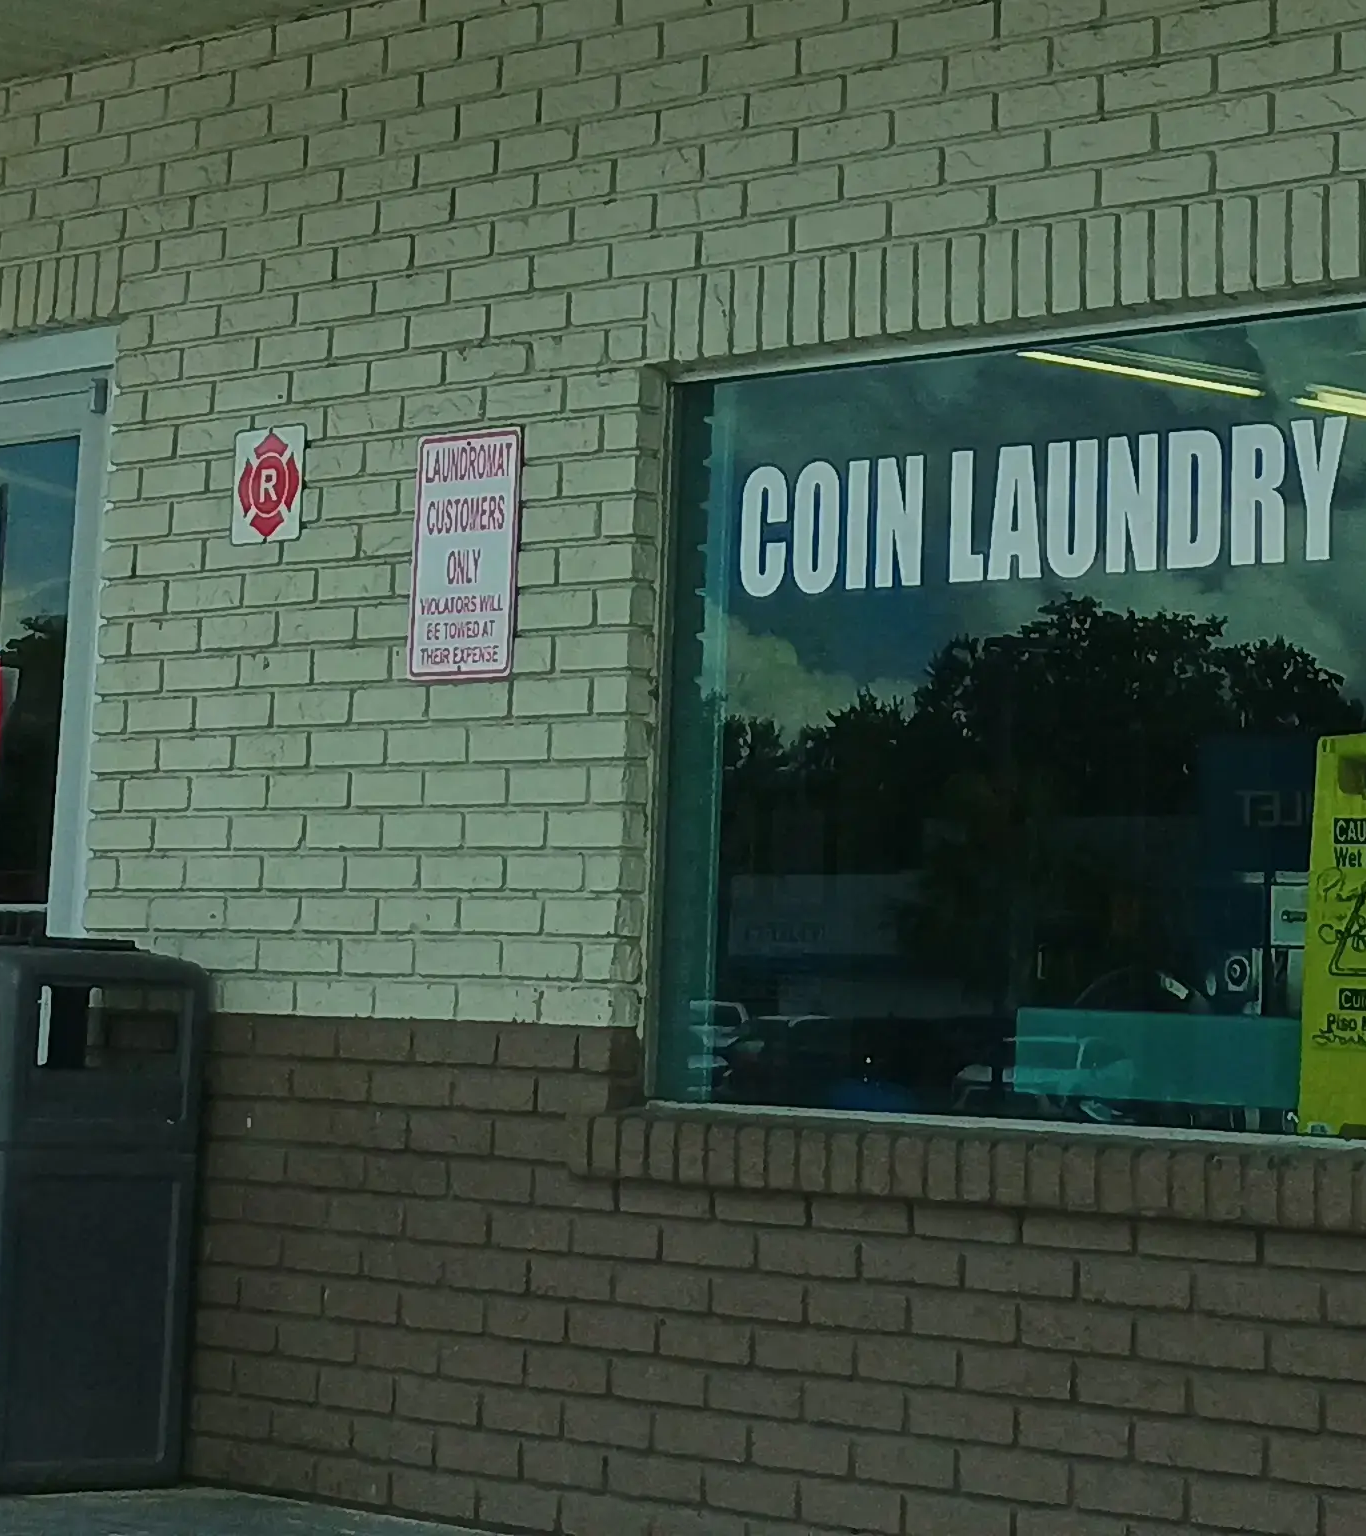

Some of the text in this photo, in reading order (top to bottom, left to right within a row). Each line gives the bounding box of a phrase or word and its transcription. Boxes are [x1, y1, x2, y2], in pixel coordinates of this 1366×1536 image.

[425, 442, 513, 484] LAUNDROMAT
[259, 468, 278, 504] R
[426, 494, 505, 536] CUSTOMERS
[739, 415, 1349, 598] COIN LAUNDRY
[446, 548, 481, 585] ONLY
[419, 593, 504, 616] VIOLATORS WILL
[426, 619, 496, 641] BE TOWED AT
[419, 644, 500, 666] THEIR EXPENSE
[1334, 847, 1362, 869] Wet
